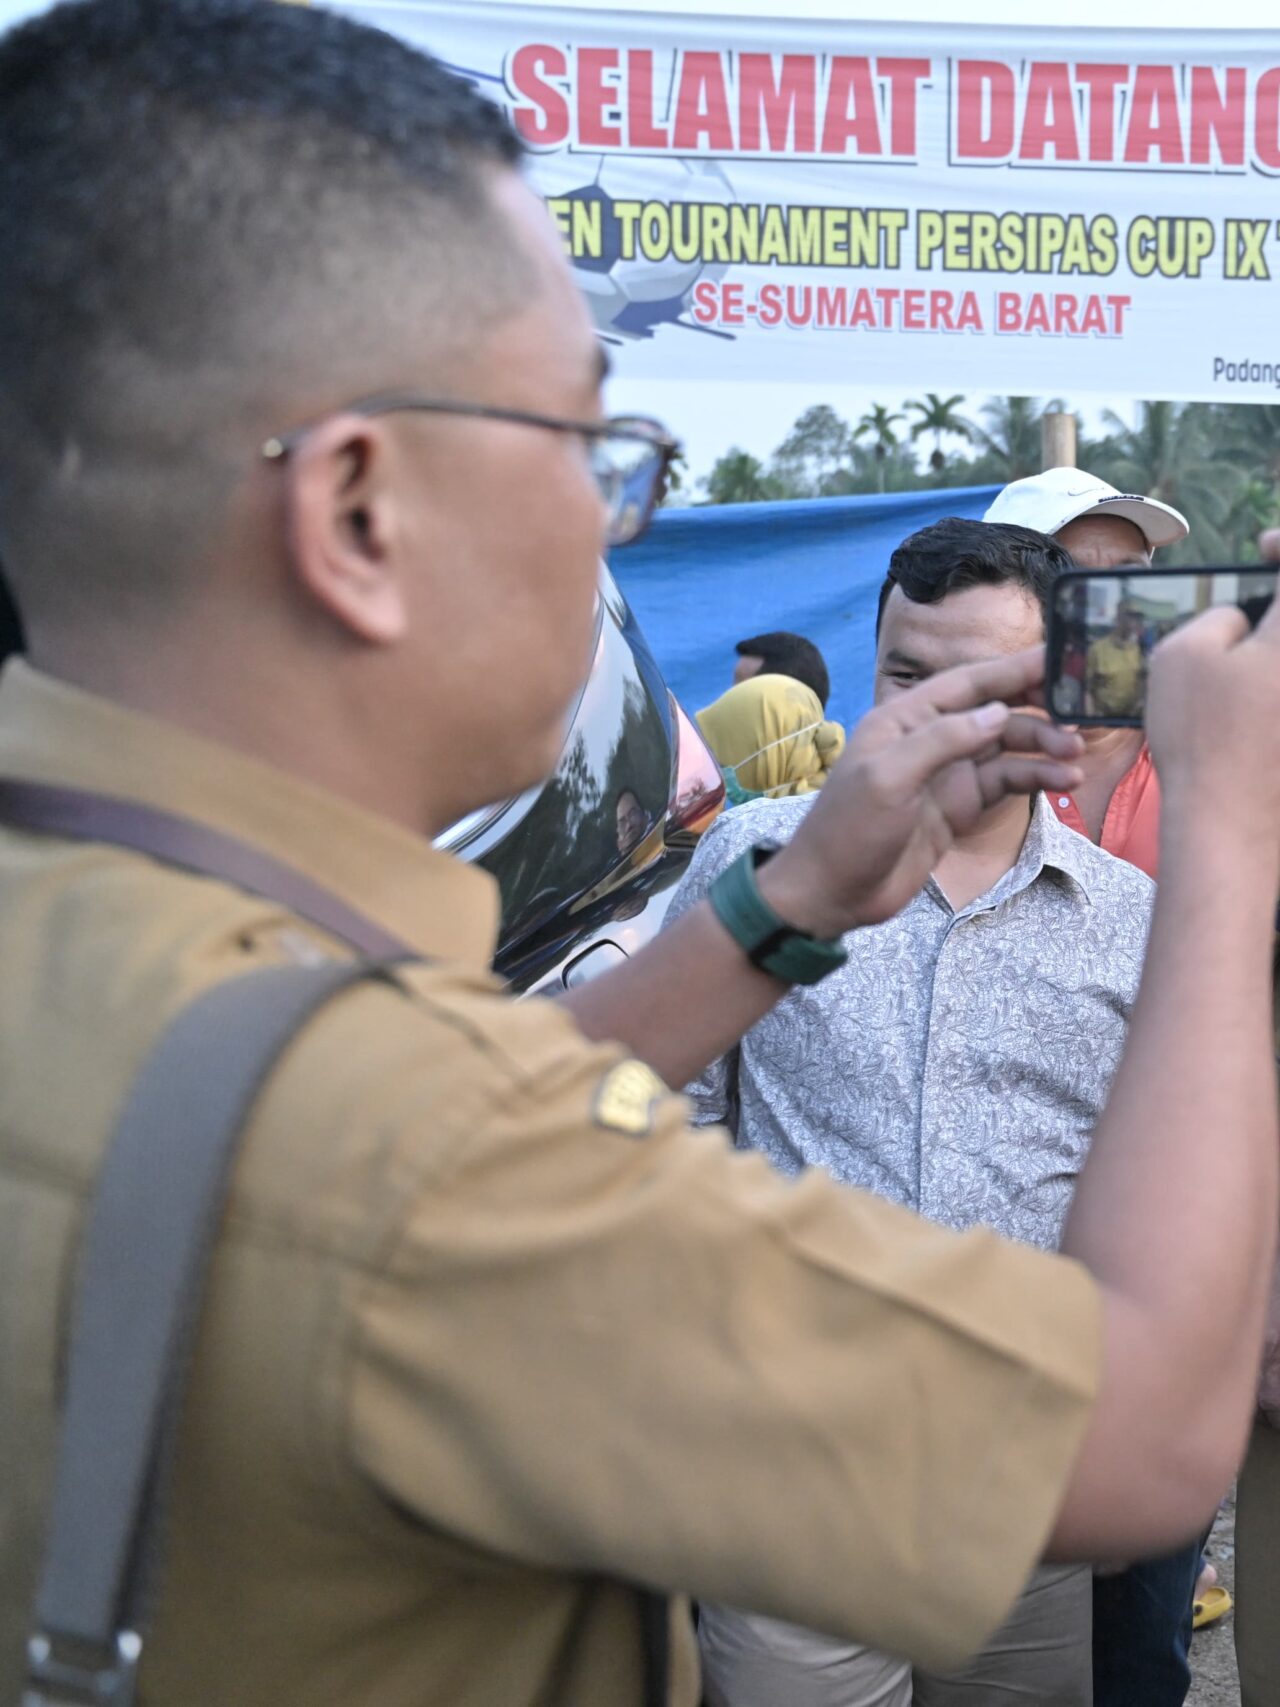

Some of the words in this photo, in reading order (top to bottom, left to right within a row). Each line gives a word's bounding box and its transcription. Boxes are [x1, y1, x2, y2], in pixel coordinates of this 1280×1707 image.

[510, 43, 932, 157] SELAMAT
[612, 200, 908, 270] TOURNAMENT
[917, 208, 1118, 277] PERSIPAS
[1127, 215, 1214, 279] CUP
[1223, 217, 1271, 281] IX
[693, 281, 984, 332] SE-SUMATERA
[998, 290, 1131, 335] BARAT
